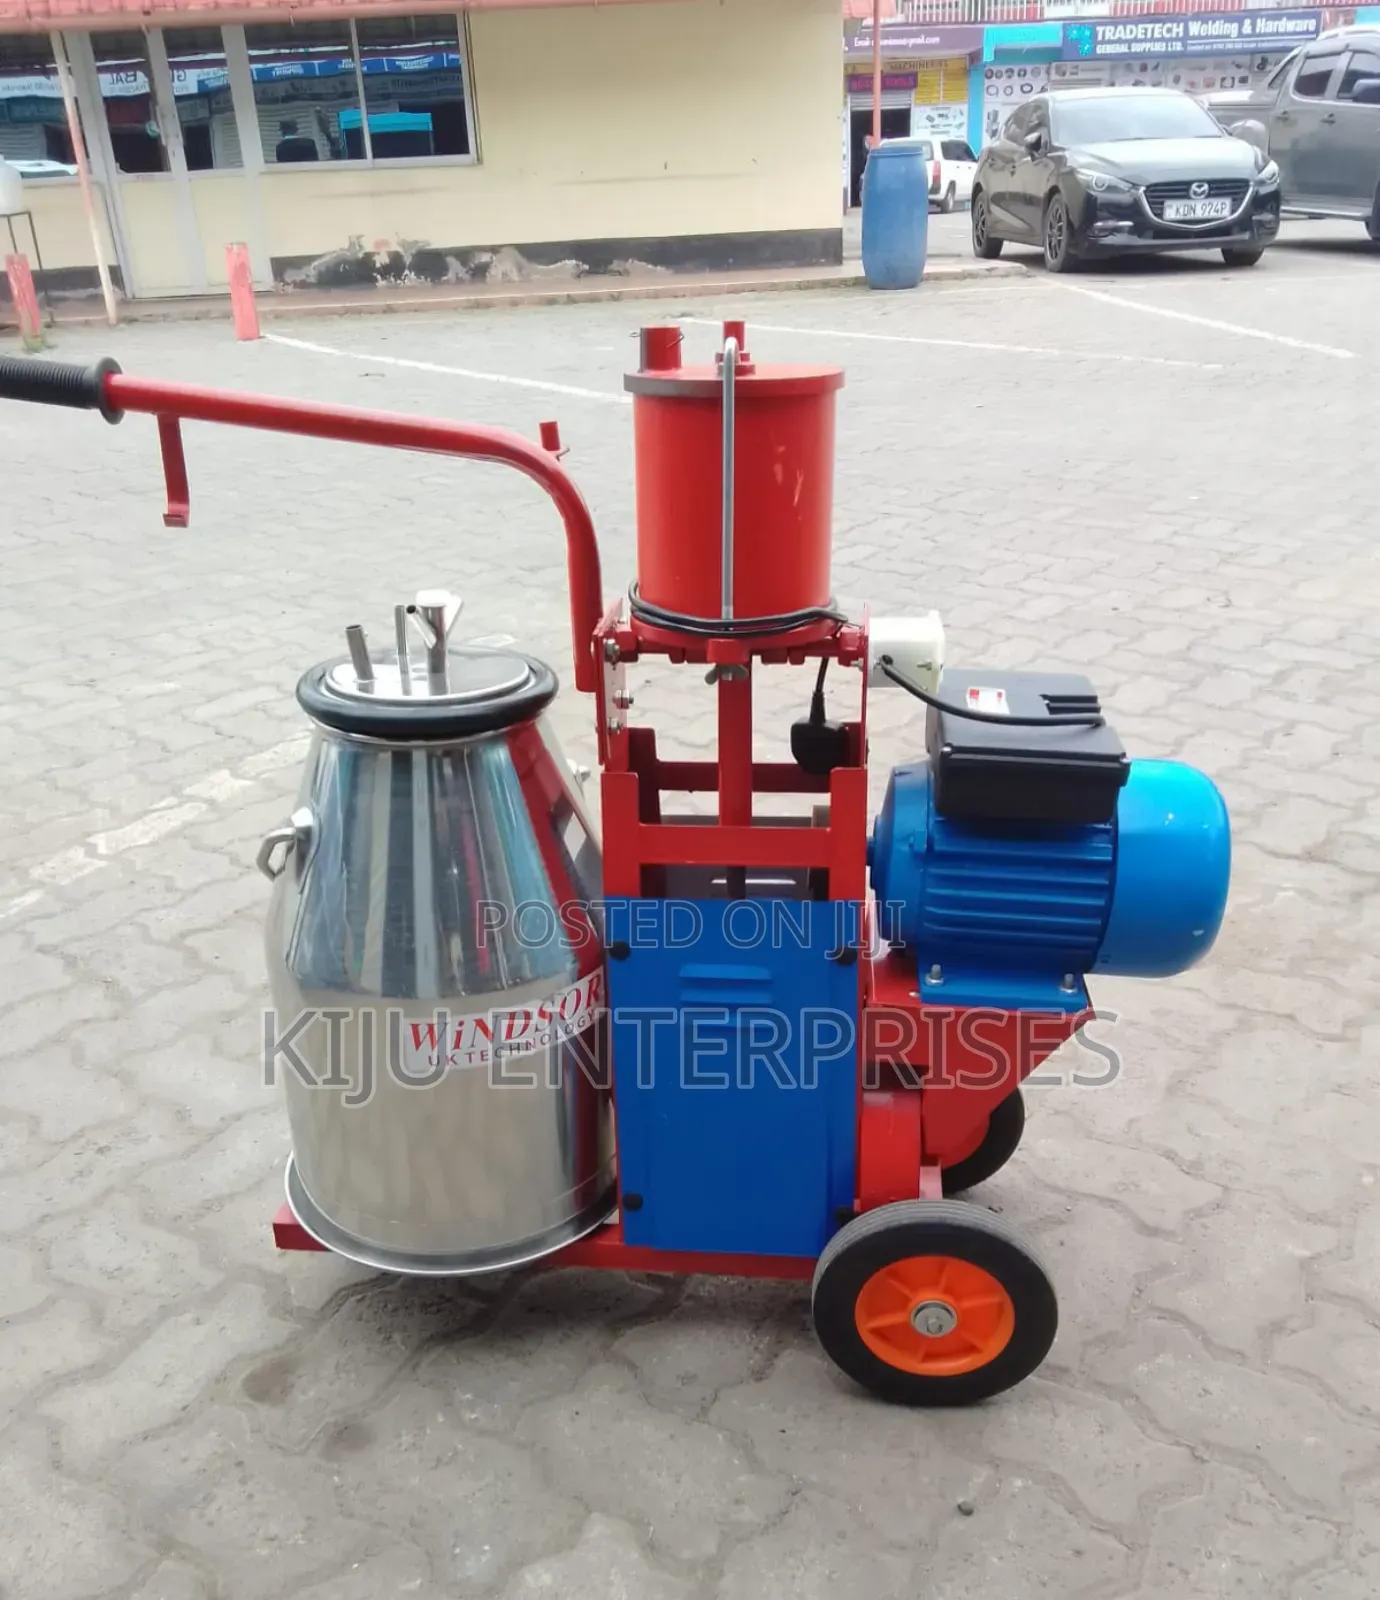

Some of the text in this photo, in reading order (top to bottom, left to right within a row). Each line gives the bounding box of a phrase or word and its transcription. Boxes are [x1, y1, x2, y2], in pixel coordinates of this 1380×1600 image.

[1096, 16, 1316, 41] TRADETECH Welding & Hardware
[1096, 43, 1129, 54] GENERAL
[1131, 42, 1167, 53] SUPPLIES
[1175, 203, 1197, 217] KDN
[428, 1051, 458, 1067] UK
